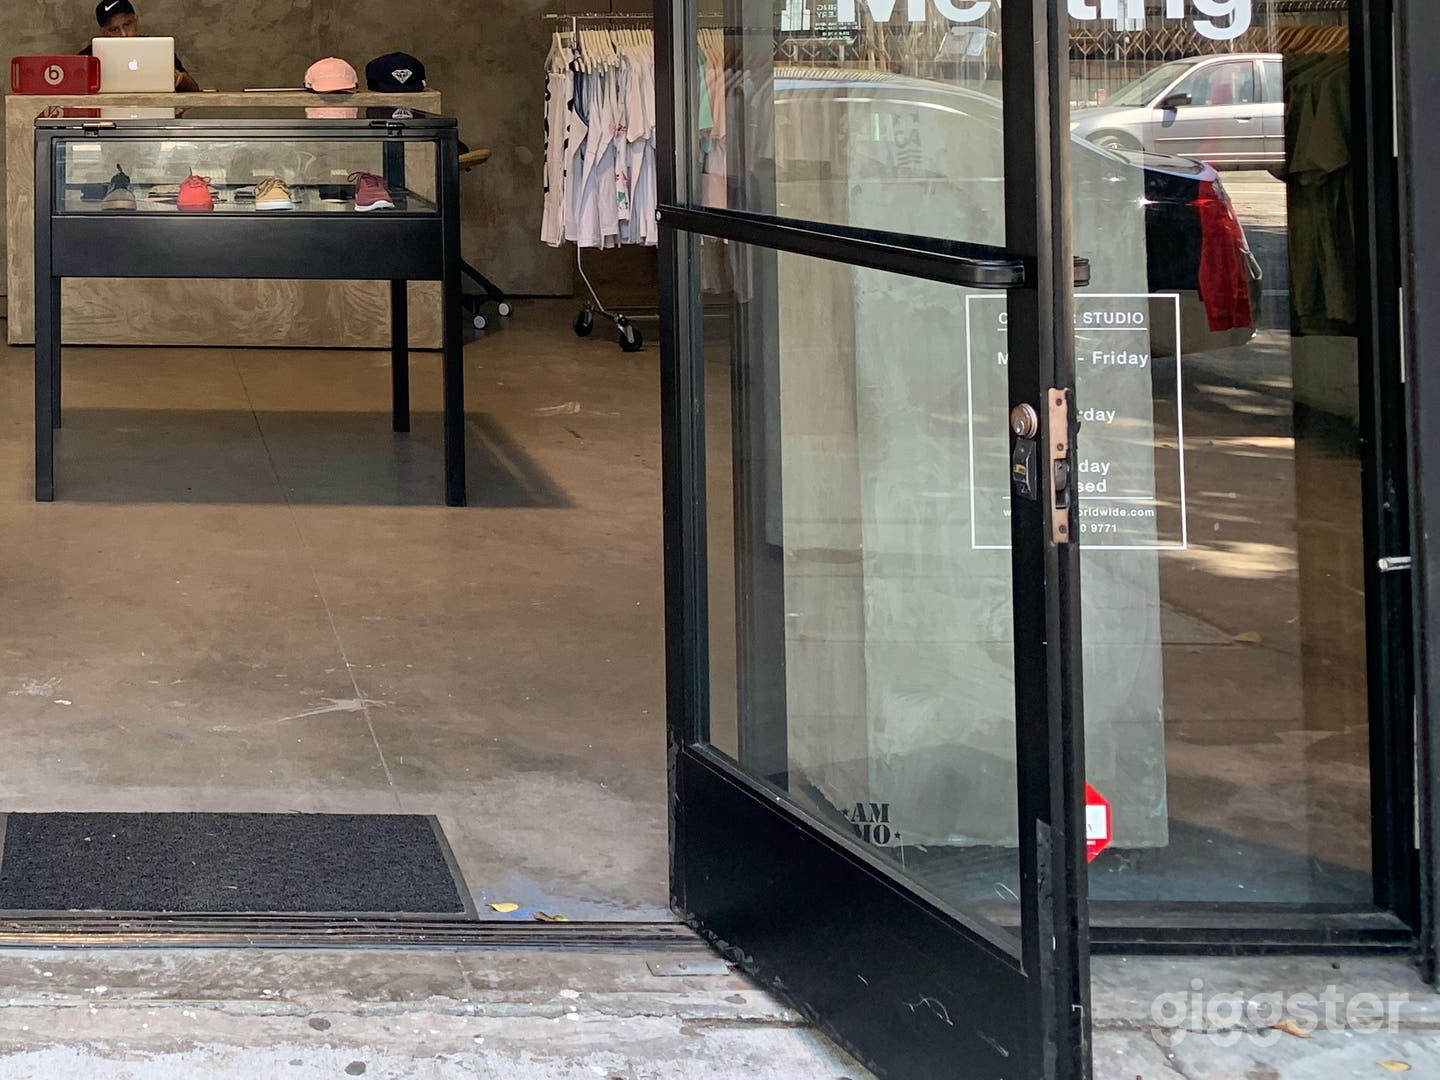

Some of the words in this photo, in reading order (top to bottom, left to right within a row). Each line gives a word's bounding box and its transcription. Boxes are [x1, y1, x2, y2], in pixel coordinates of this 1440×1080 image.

[1083, 312, 1144, 324] STUDIO
[1093, 351, 1148, 367] Friday
[1091, 524, 1117, 533] 9771
[851, 803, 890, 823] AM
